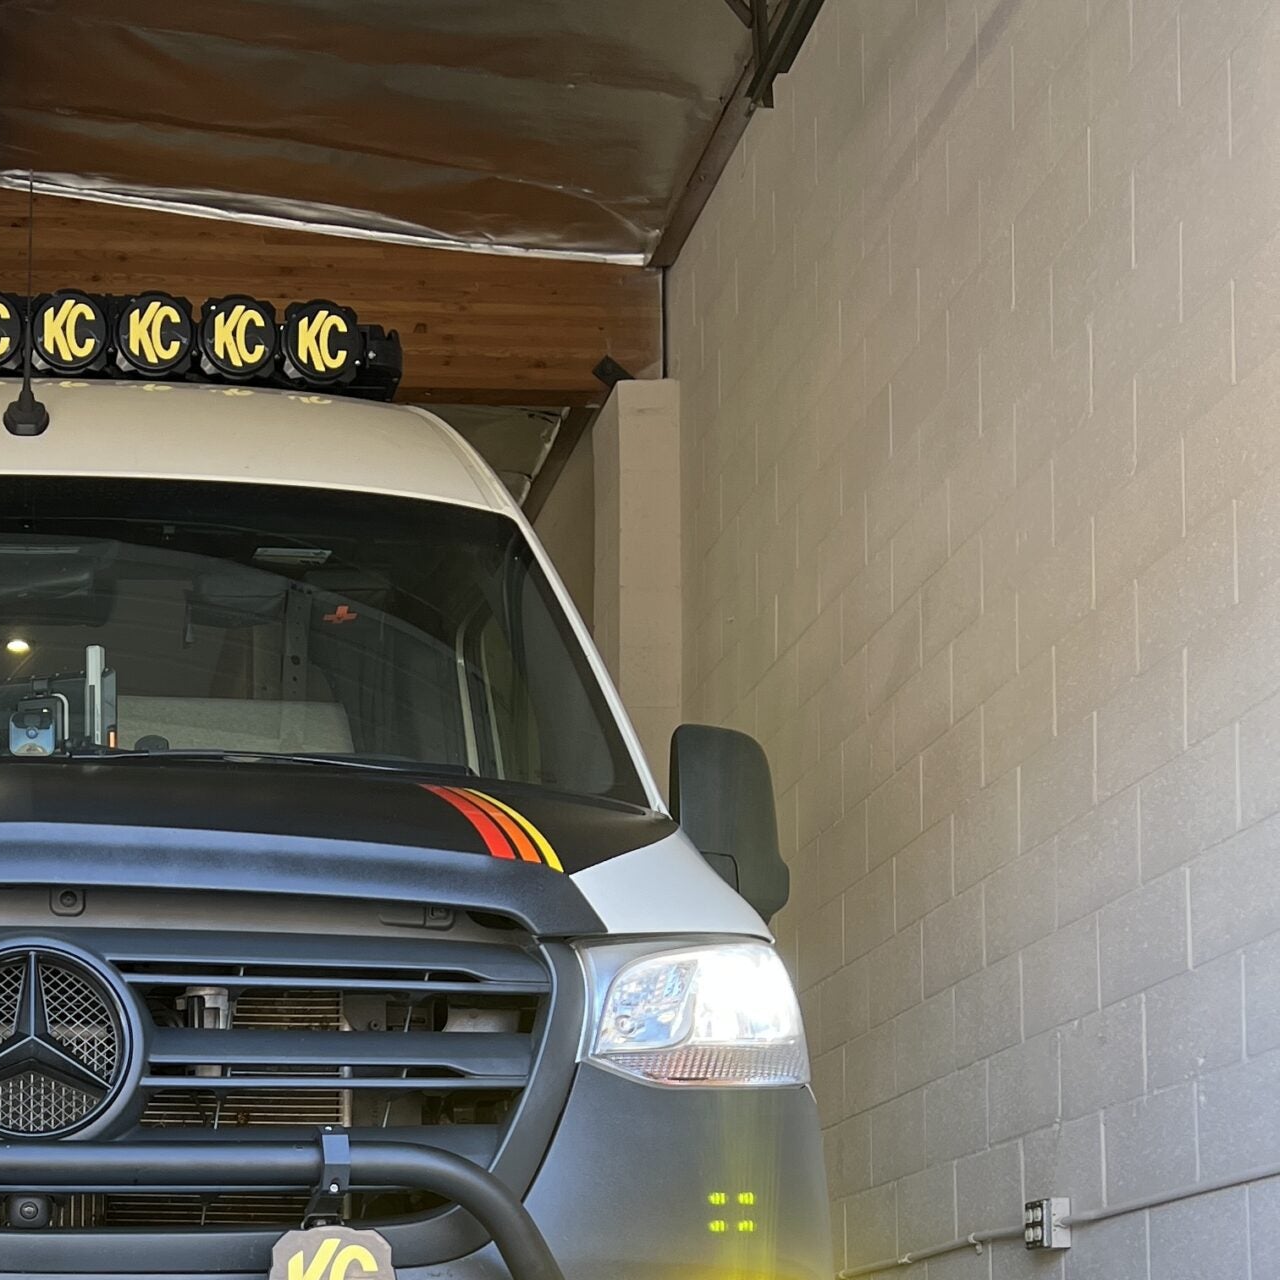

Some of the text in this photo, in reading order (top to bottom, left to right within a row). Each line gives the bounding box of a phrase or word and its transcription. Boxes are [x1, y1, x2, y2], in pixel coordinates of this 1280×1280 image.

[44, 300, 95, 361] KC
[130, 304, 180, 363] KC
[215, 307, 265, 366] KC
[299, 312, 348, 371] KC
